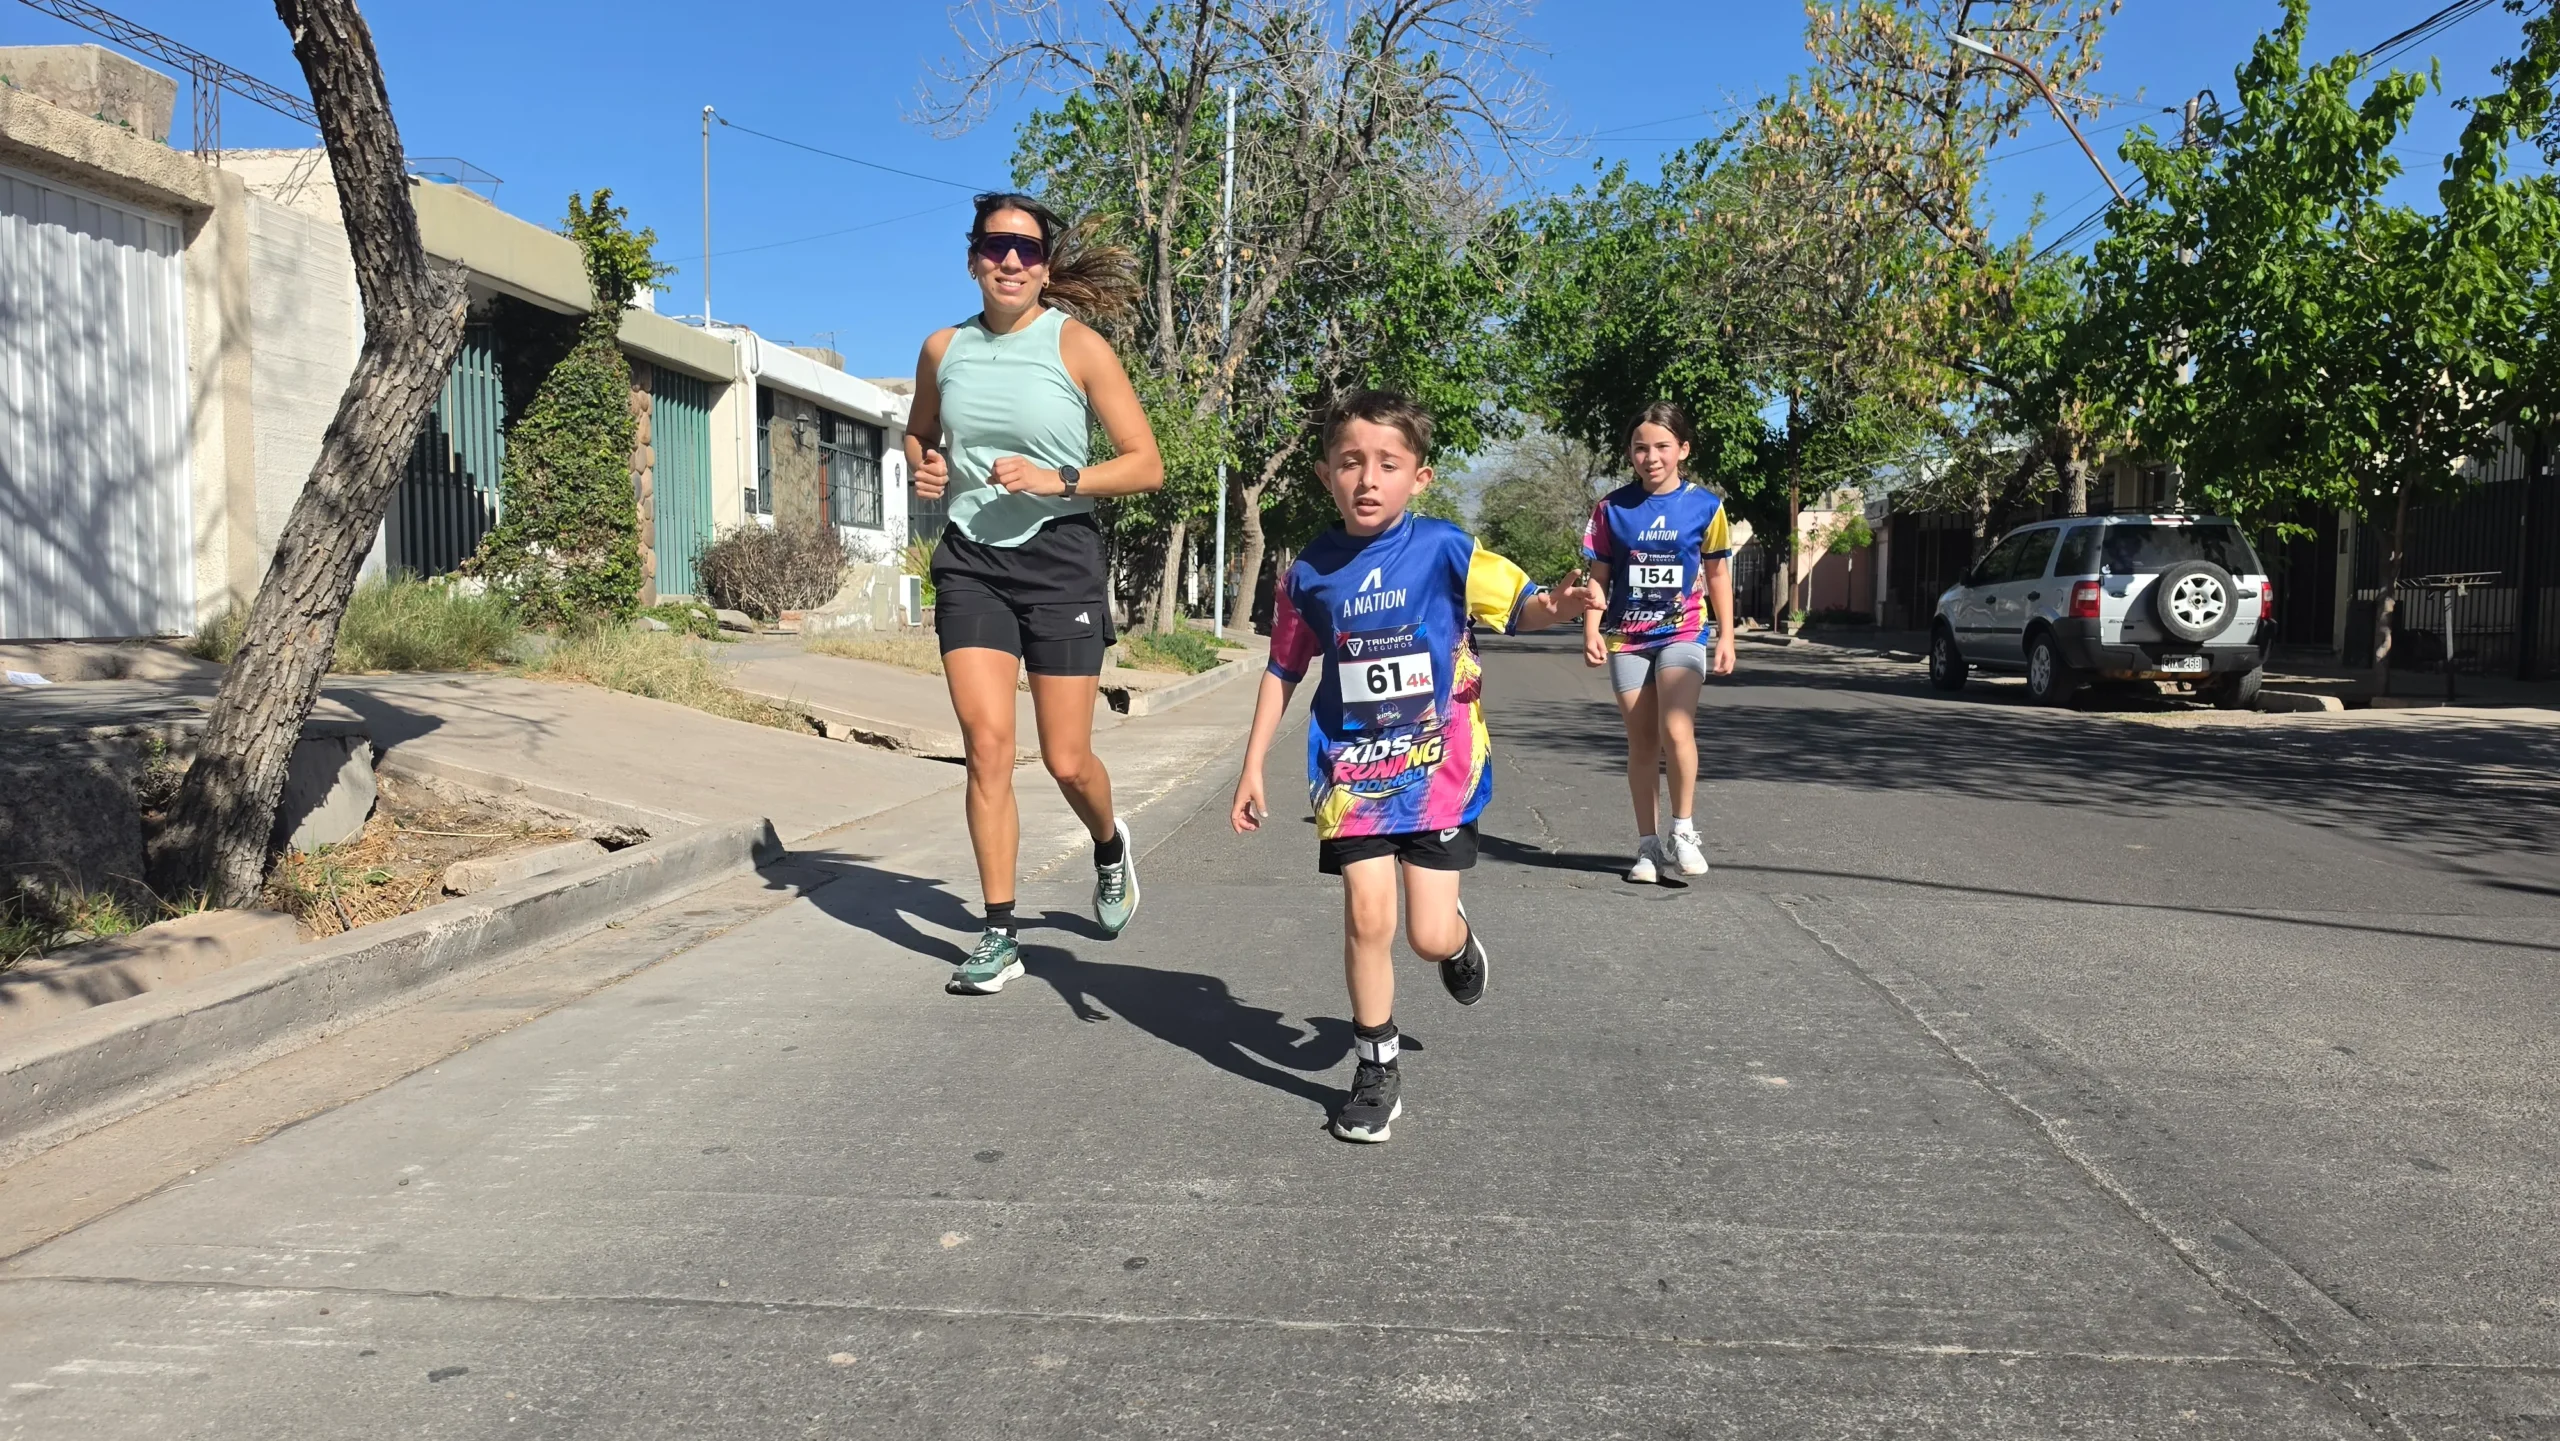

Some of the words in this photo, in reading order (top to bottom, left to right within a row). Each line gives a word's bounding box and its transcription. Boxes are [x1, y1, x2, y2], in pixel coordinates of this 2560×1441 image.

[1638, 531, 1645, 541] A
[1645, 529, 1678, 541] NATION
[1640, 567, 1675, 584] 154
[1343, 599, 1352, 618] A
[1354, 588, 1407, 616] NATION
[1622, 610, 1666, 621] KIDS
[1365, 634, 1413, 646] TRIUNFO
[1368, 641, 1413, 653] SEGUROS
[2183, 657, 2201, 669] 268
[1366, 662, 1403, 694] 61
[1338, 734, 1413, 763] KIDS
